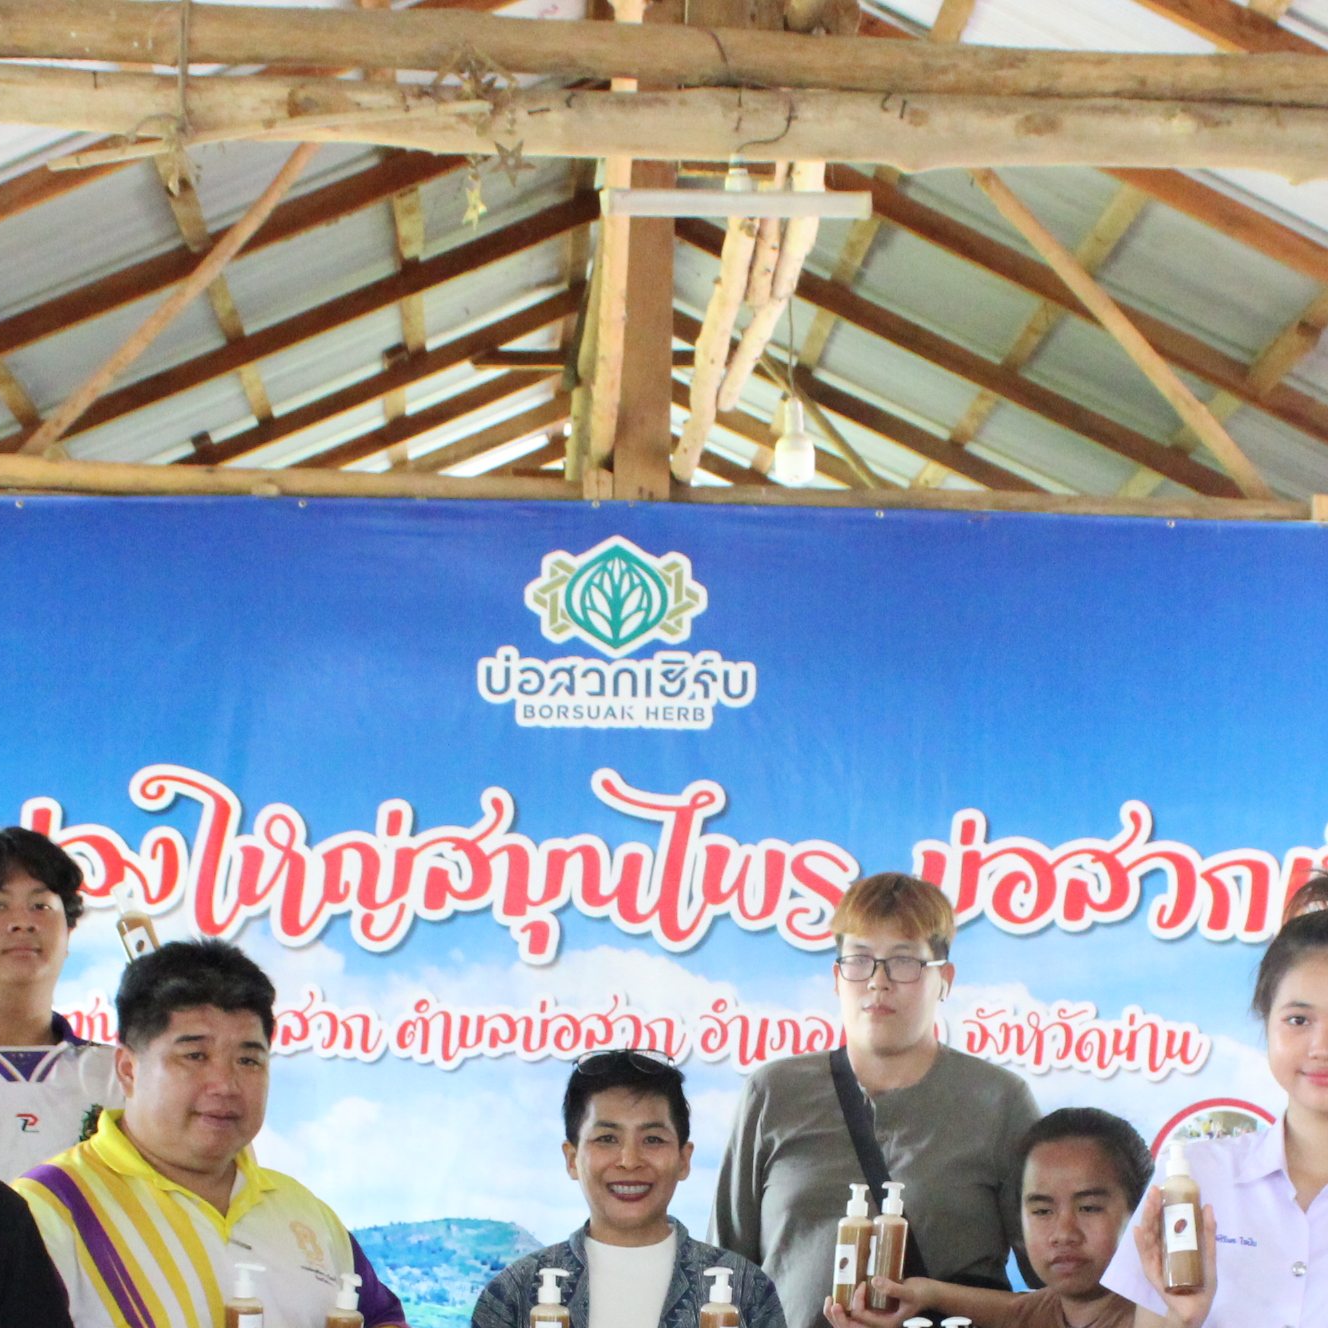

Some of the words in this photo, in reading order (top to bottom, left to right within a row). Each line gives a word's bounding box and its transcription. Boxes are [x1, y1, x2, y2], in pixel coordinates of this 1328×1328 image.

[522, 705, 635, 721] BORSUAK
[645, 705, 707, 722] HERB
[962, 1007, 1204, 1073] จังหวัดน่าน
